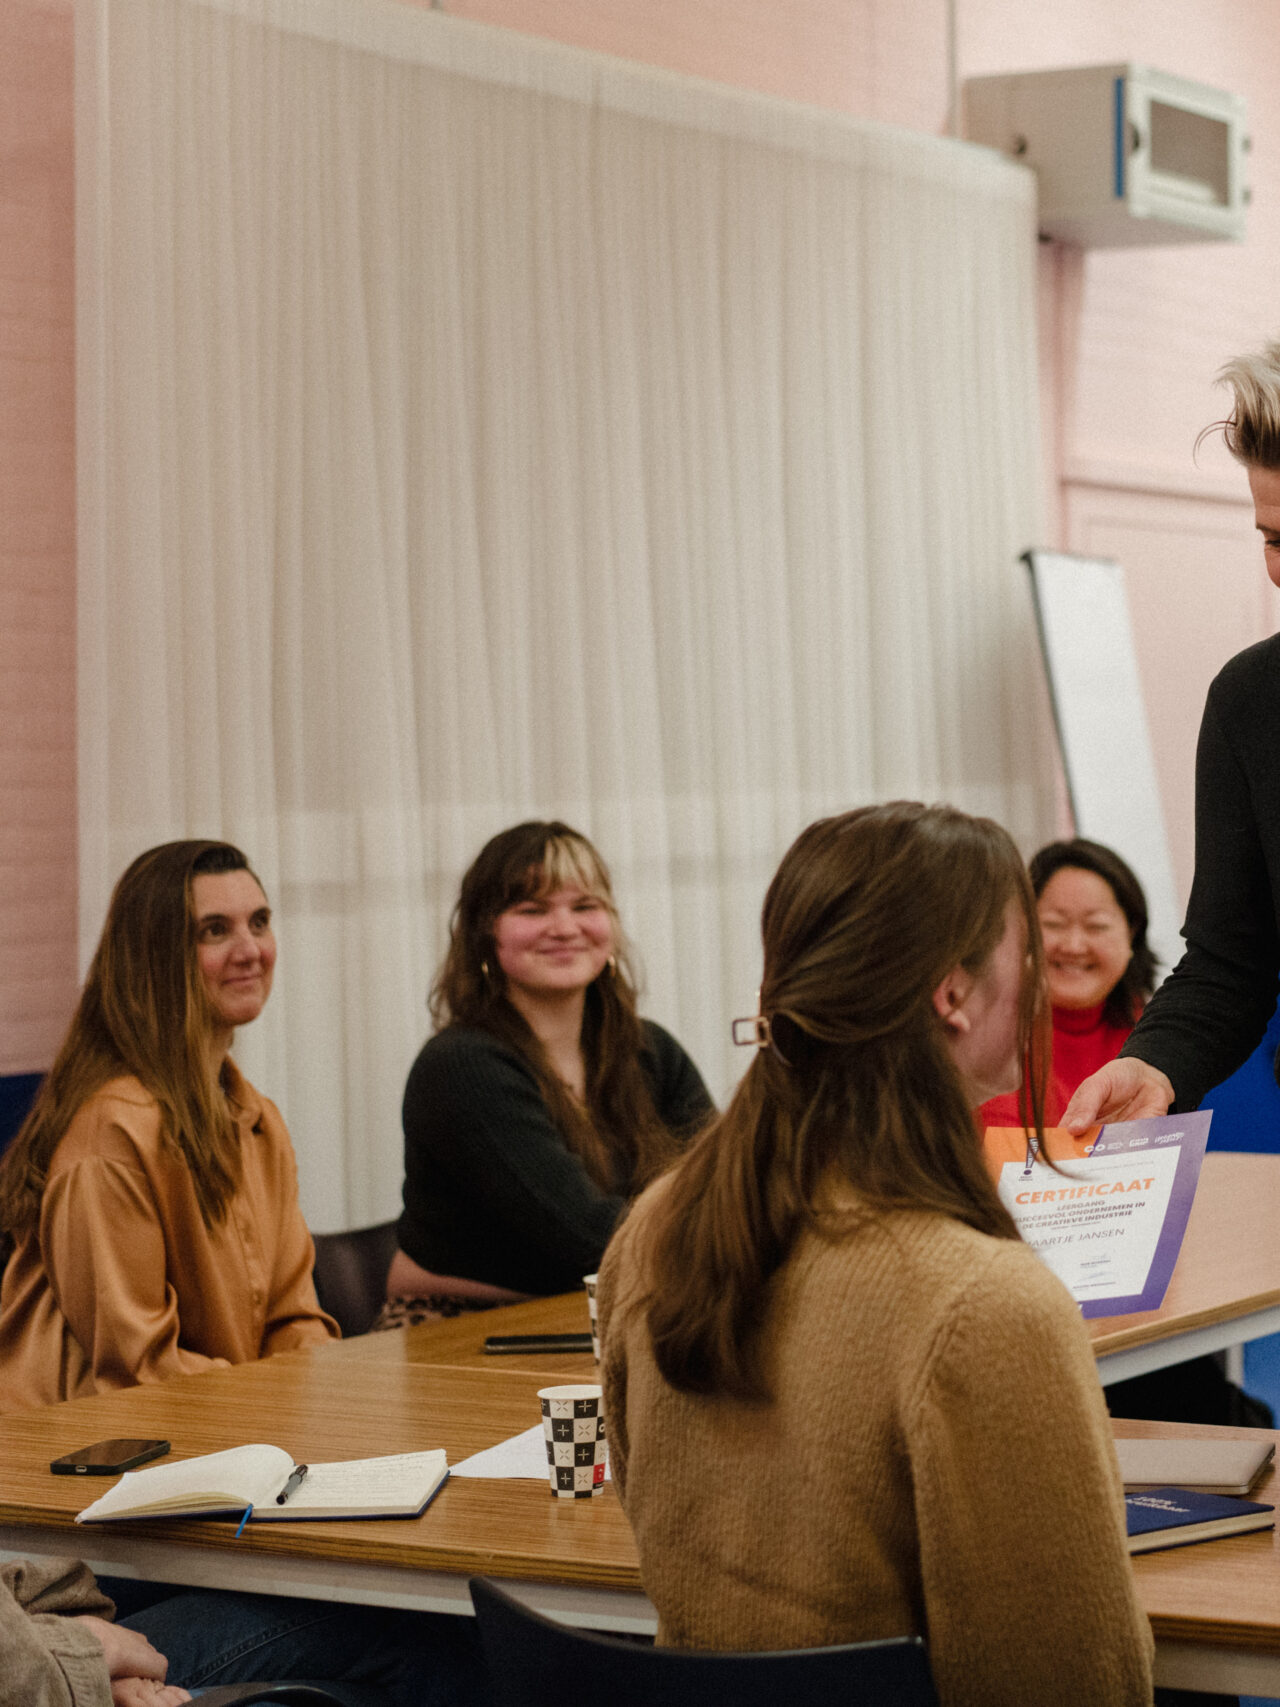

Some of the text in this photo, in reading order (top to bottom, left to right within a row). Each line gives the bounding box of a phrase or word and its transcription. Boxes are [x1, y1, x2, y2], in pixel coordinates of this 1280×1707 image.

[1015, 1178, 1155, 1205] CERTIFICAAT
[1057, 1200, 1105, 1211] LEERGANG
[1068, 1204, 1133, 1217] ONDERNEMEN
[1035, 1216, 1083, 1228] CREATIEVE
[1084, 1210, 1133, 1222] INDUSTRIE
[1078, 1228, 1125, 1241] JANSEN
